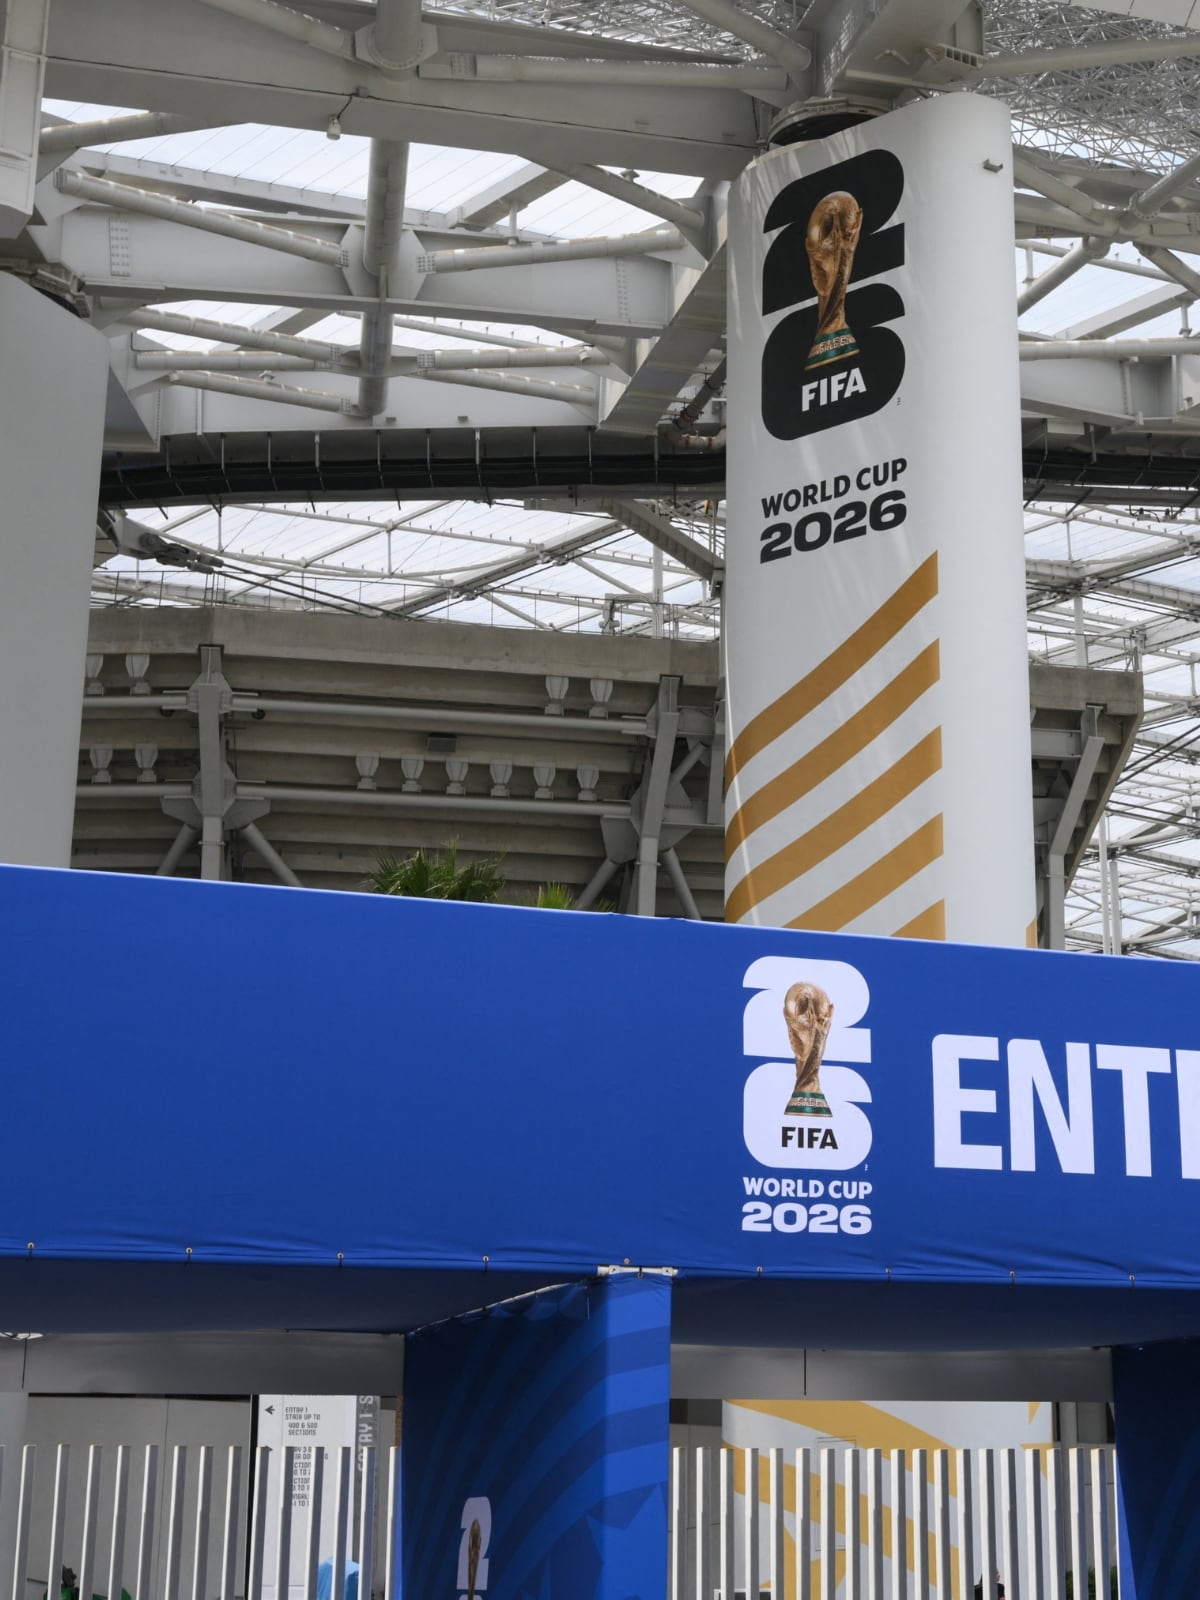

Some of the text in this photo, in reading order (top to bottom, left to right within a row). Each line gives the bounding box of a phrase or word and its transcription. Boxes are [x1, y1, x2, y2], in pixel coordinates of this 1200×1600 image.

[802, 368, 867, 411] FIFA
[761, 458, 908, 519] WORLD CUP
[760, 490, 908, 564] 2026
[781, 1126, 838, 1149] FIFA
[743, 1177, 872, 1199] WORLD CUP
[742, 1202, 872, 1235] 2026
